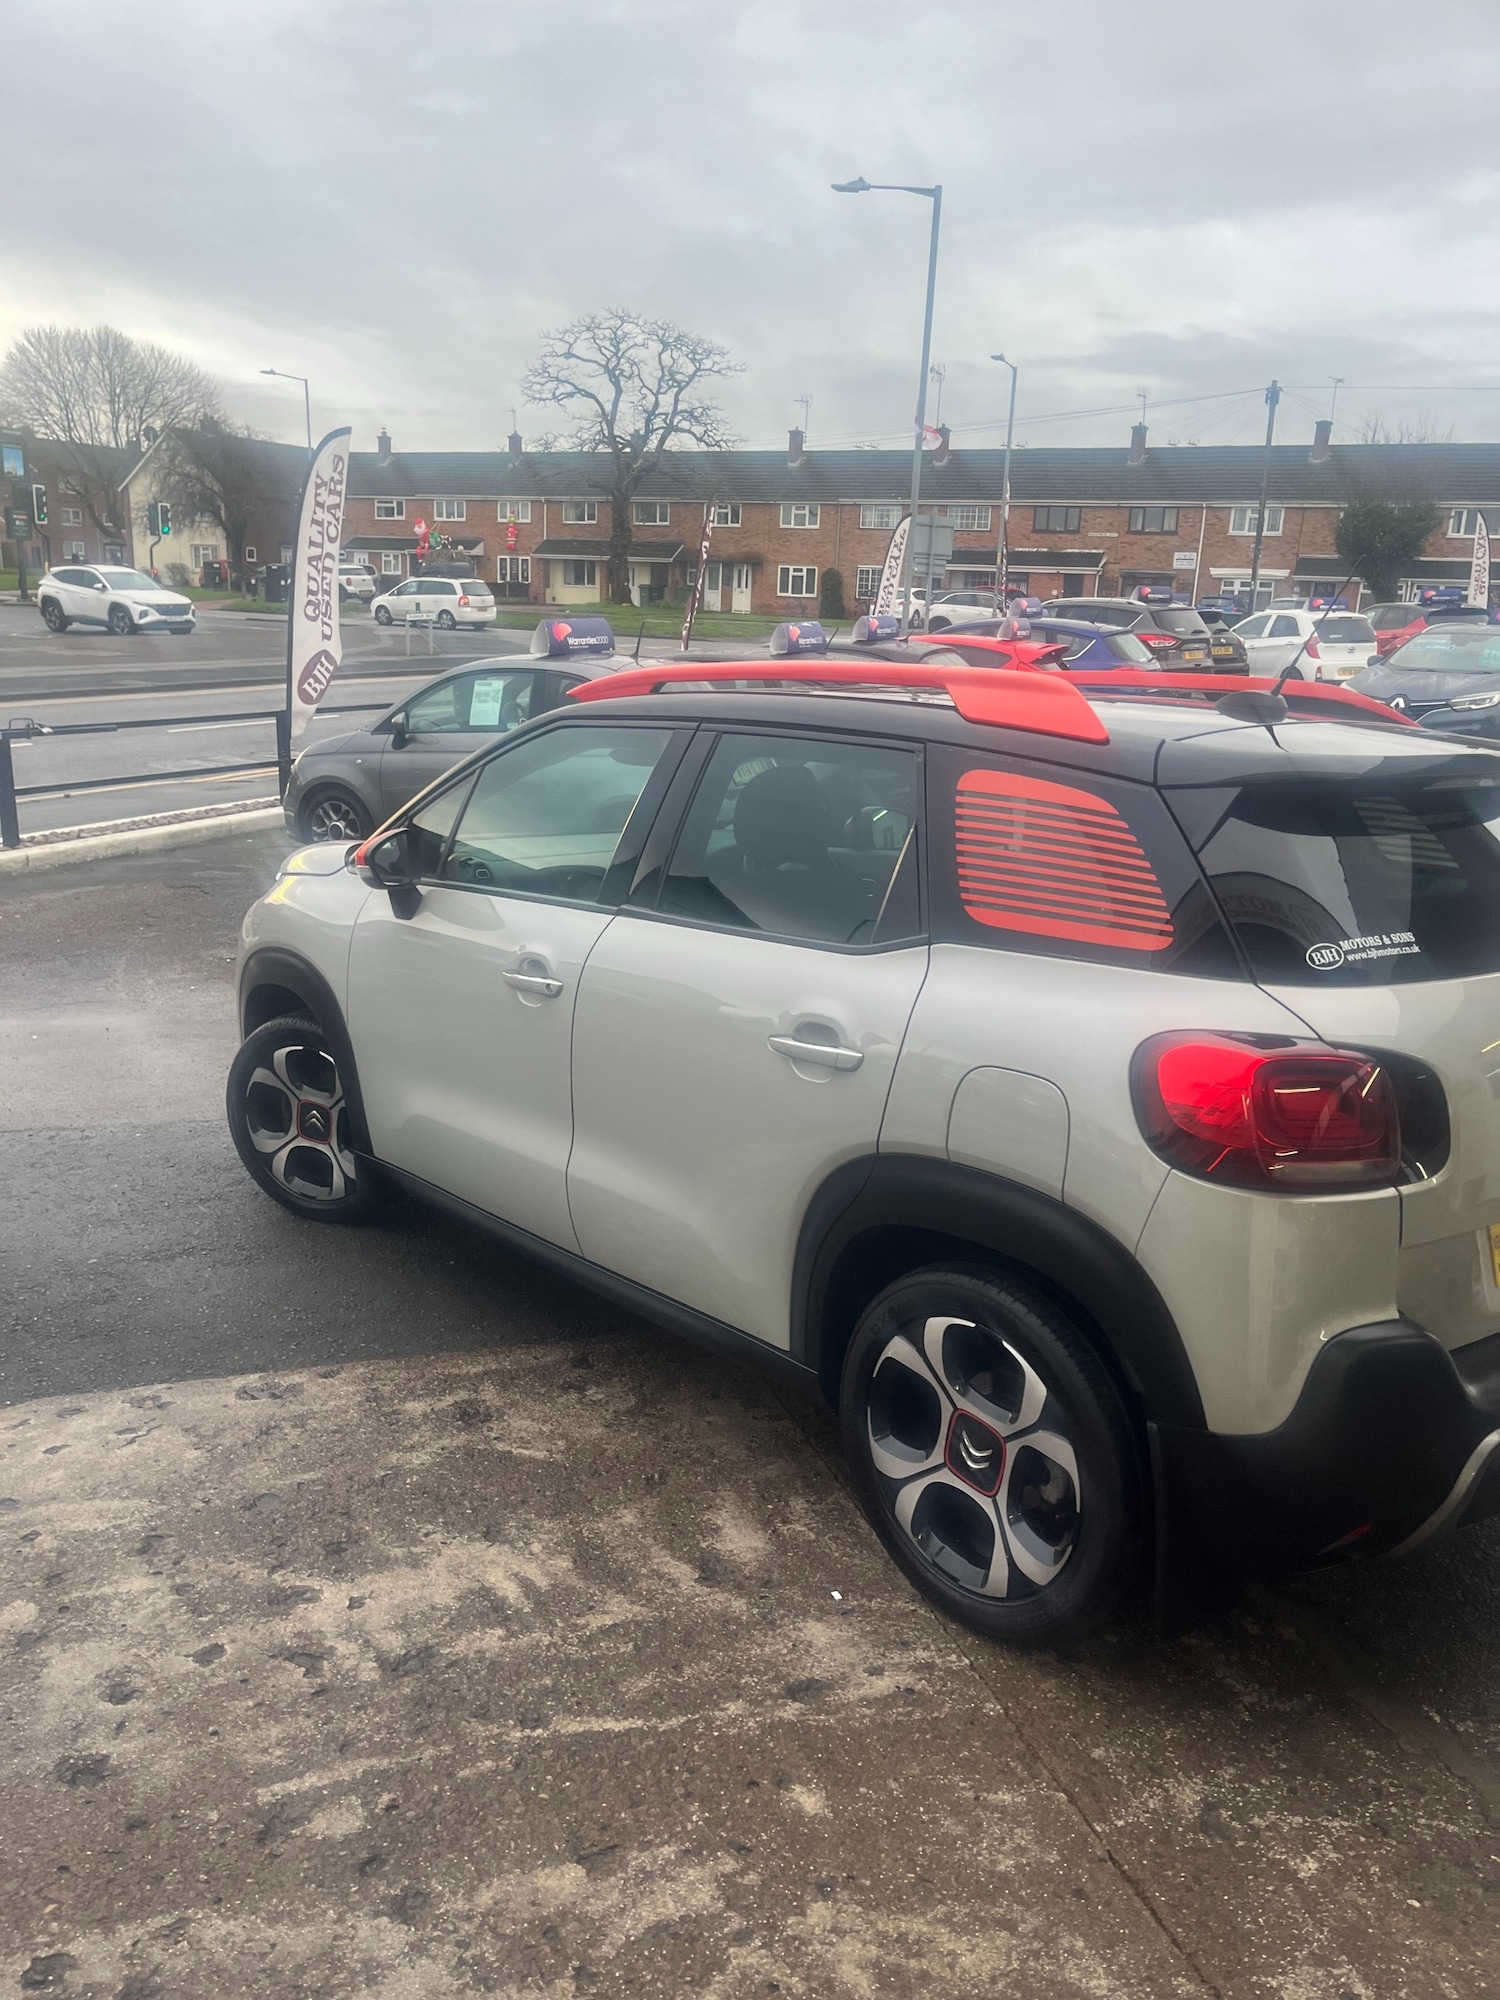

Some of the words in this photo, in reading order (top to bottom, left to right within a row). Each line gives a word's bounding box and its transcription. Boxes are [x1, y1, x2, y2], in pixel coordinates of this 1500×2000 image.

[326, 454, 345, 545] CARS
[304, 470, 328, 623] QUALITY
[321, 551, 335, 642] USED
[567, 635, 609, 646] Warranties2000
[302, 654, 335, 700] BJH
[1310, 949, 1340, 965] BJH
[1339, 937, 1382, 951] MOTORS
[1383, 935, 1391, 944] &
[1391, 932, 1416, 944] SONS
[1346, 944, 1421, 960] www.bjhmotors.co.uk
